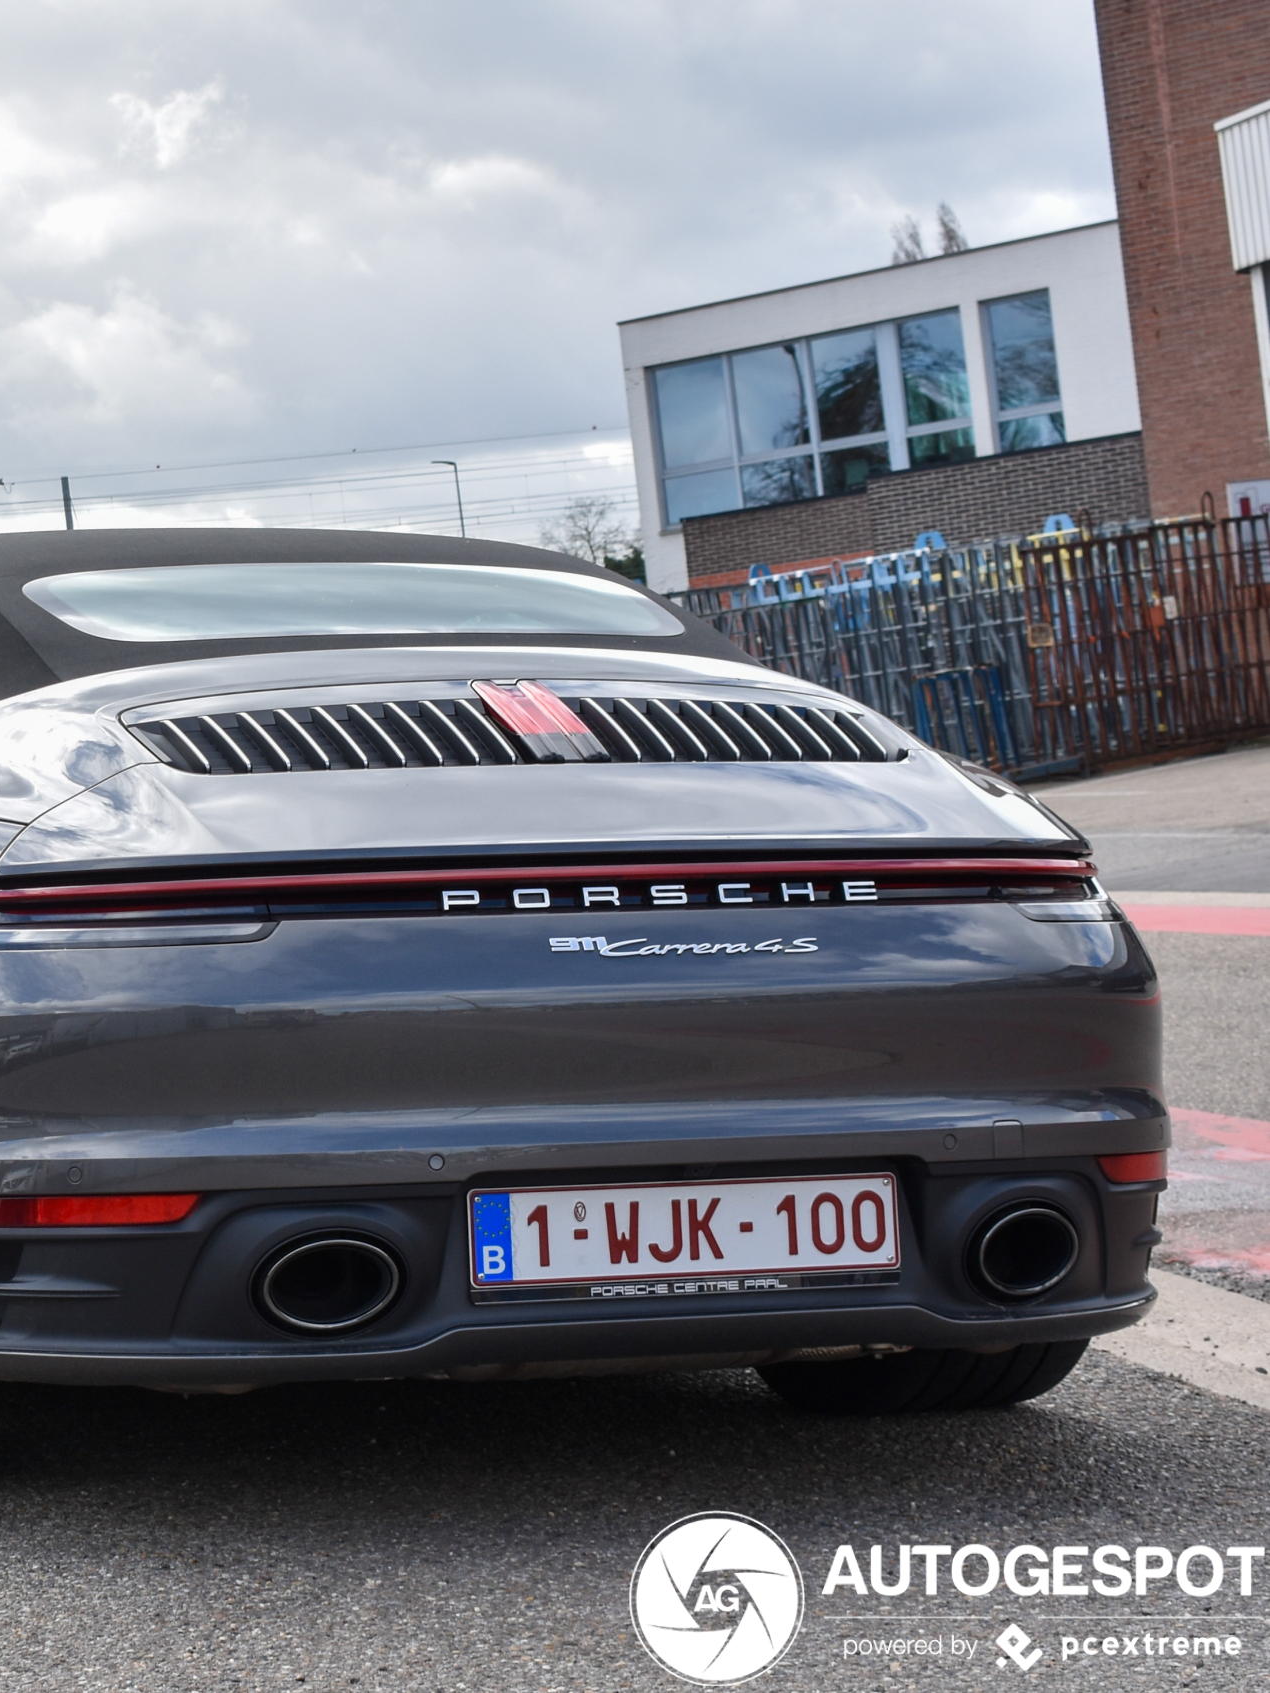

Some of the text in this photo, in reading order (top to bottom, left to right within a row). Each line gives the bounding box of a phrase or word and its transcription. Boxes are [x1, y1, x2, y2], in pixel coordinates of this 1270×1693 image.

[442, 881, 878, 911] PORSCHE
[599, 937, 751, 957] Carrera
[526, 1189, 887, 1268] 1-WJK-100
[481, 1245, 506, 1275] B
[590, 1278, 788, 1297] PORSCHE CENTRE PAAL
